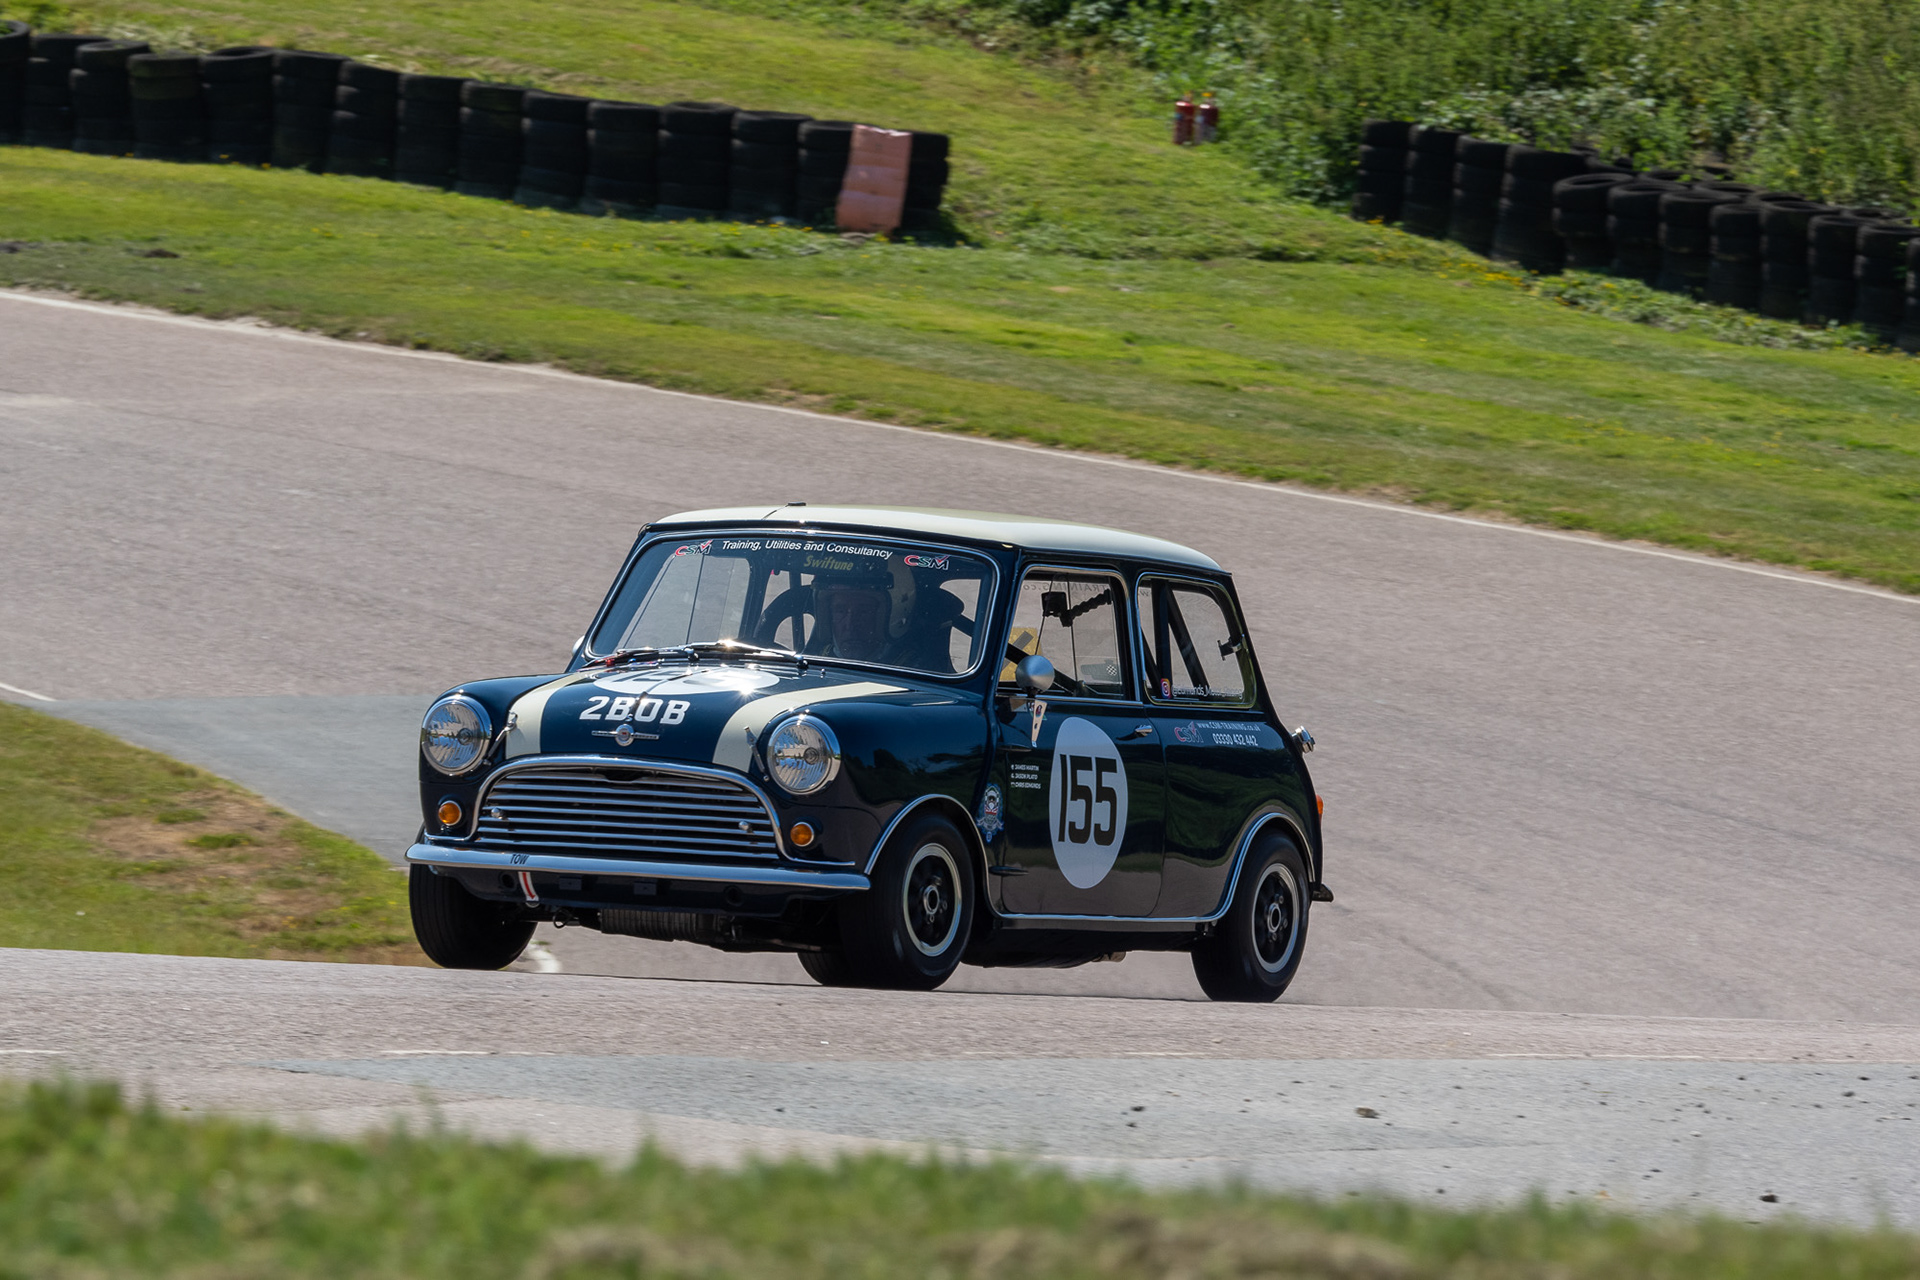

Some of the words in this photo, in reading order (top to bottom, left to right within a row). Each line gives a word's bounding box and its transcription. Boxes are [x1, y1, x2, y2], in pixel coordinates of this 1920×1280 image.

[675, 541, 712, 556] CSM
[722, 540, 761, 551] Training,
[765, 540, 801, 551] Utilities
[803, 542, 824, 551] and
[826, 542, 893, 560] Consultancy
[803, 555, 854, 571] Swiftune
[904, 555, 950, 571] CSM
[579, 696, 691, 725] 2BOB
[1212, 733, 1234, 745] 03330
[1234, 734, 1246, 746] 432
[1246, 735, 1259, 746] 442
[1058, 754, 1118, 846] 155
[510, 853, 530, 864] TOW
